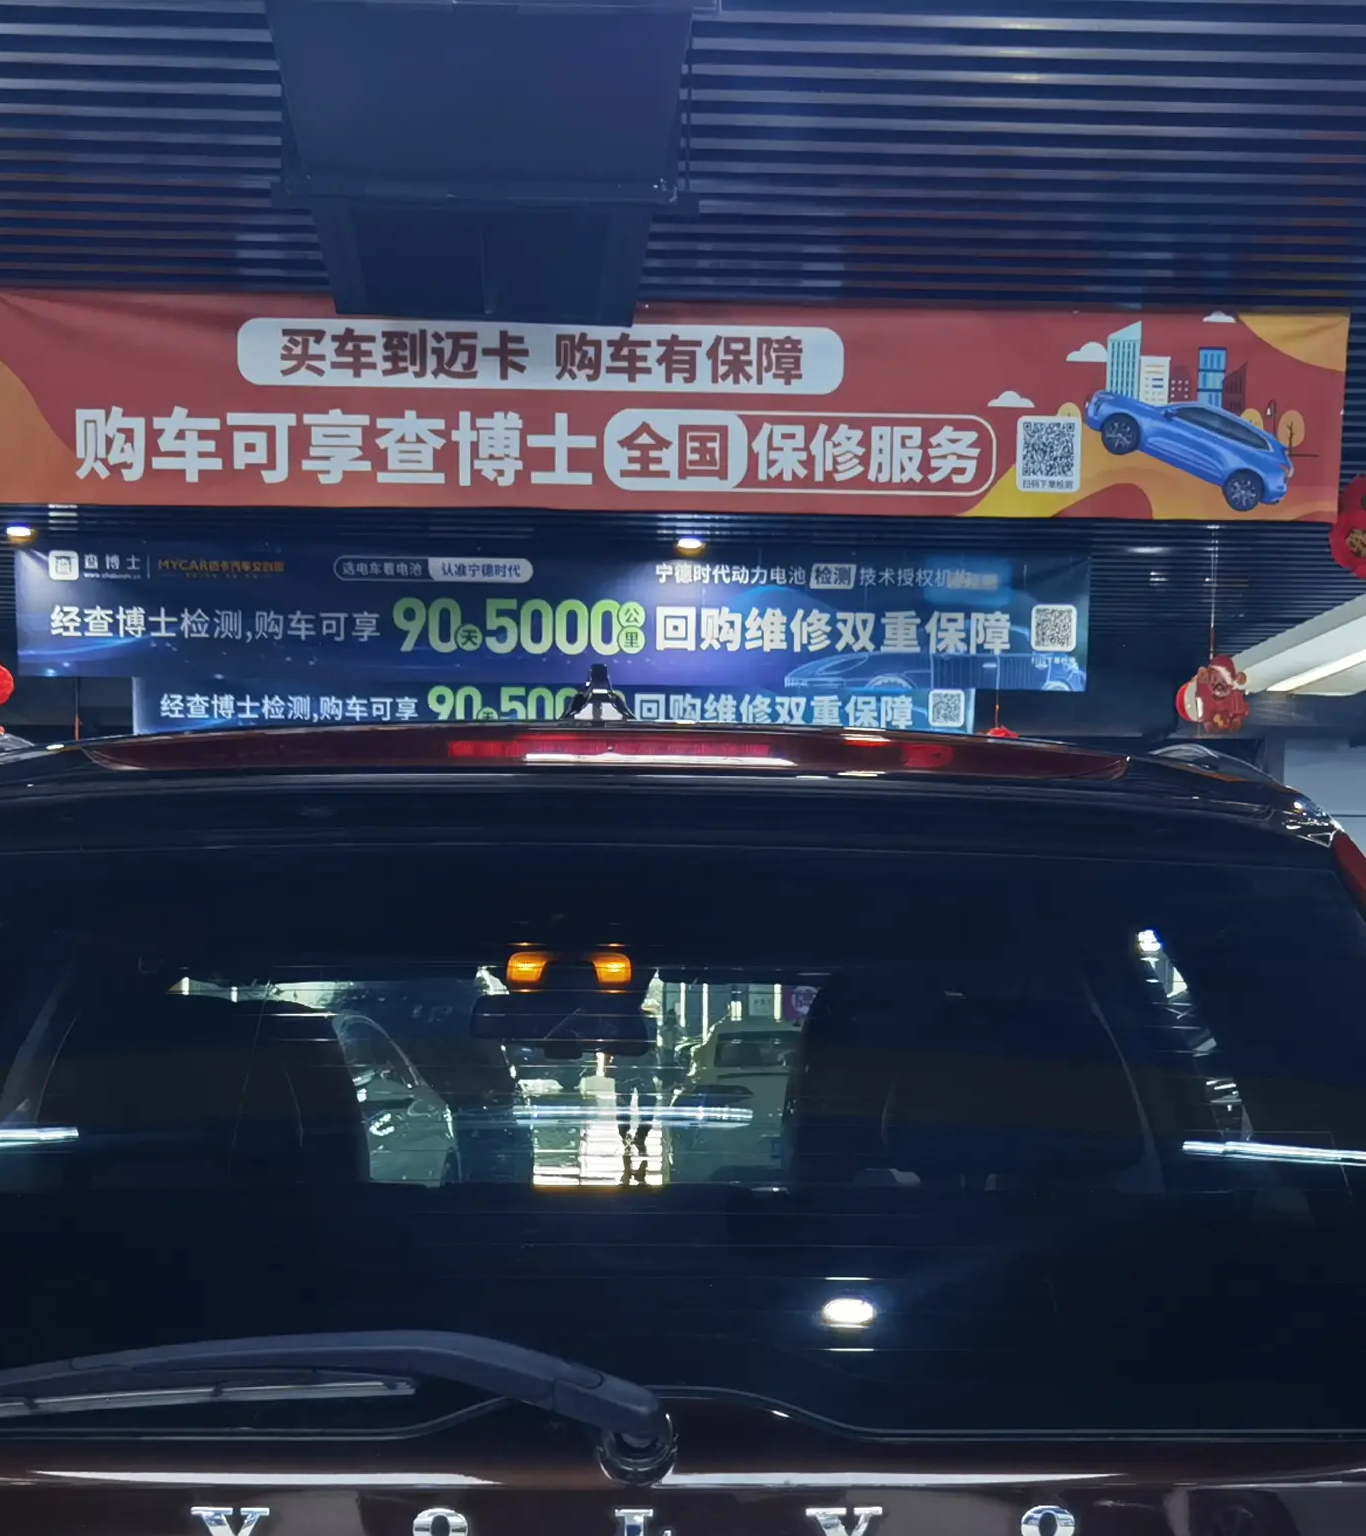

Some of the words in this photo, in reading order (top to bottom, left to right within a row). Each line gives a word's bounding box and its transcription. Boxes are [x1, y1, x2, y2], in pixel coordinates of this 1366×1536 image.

[280, 328, 530, 380] 买车到迈卡
[554, 333, 804, 386] 购车有保障
[75, 406, 597, 487] 购车可享查博士
[617, 420, 730, 482] 全国
[751, 422, 983, 486] 保修服务
[84, 553, 141, 571] 查博士
[441, 562, 522, 578] 认准宁德时代
[655, 563, 807, 587] 宁德时代动力电池
[814, 565, 853, 587] 检测
[49, 605, 381, 642] 经查博士检测,购车可享
[655, 606, 1011, 656] 回购维修双重保障
[160, 693, 419, 721] 经查博士检测,购车可享
